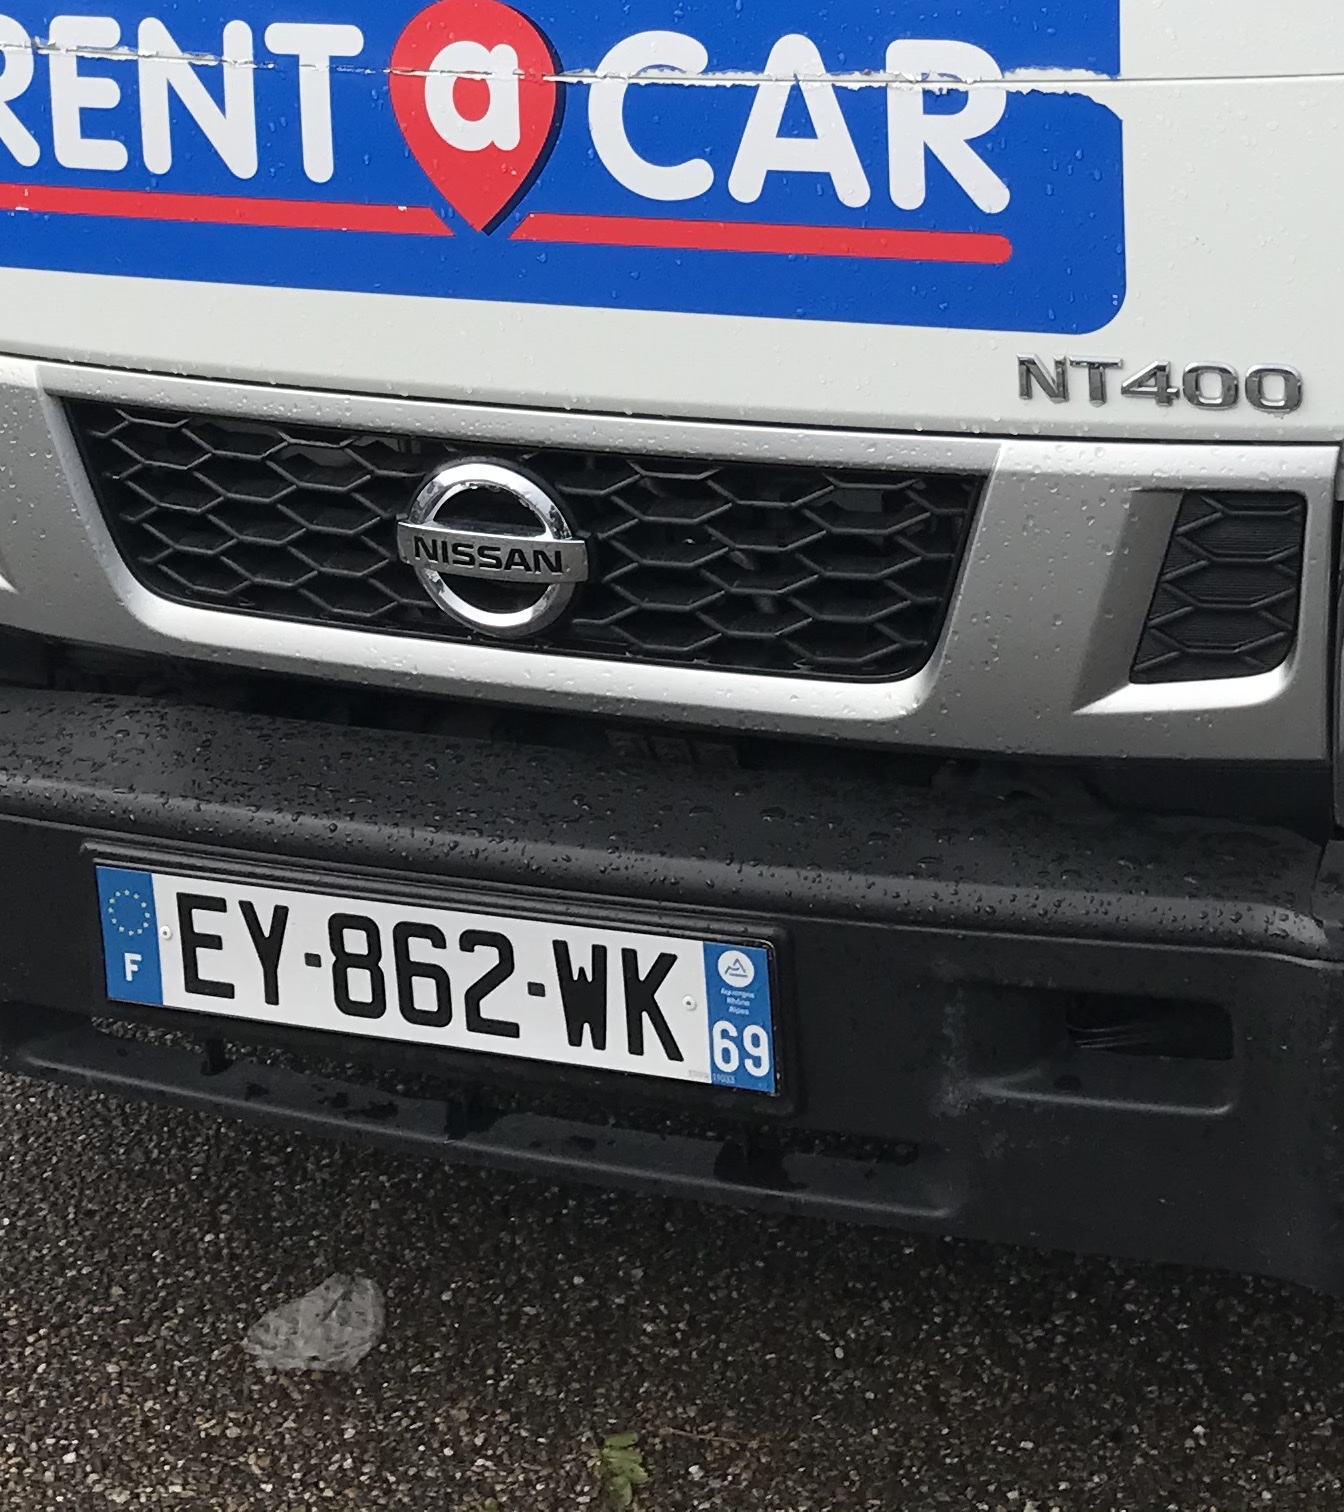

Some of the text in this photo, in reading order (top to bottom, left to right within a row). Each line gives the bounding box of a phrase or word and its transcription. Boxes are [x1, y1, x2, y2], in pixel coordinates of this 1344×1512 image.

[588, 30, 1011, 214] CAR
[1016, 352, 1304, 414] NT400
[413, 535, 563, 576] NISSAN
[124, 891, 770, 1077] F EY-862-WK 69
